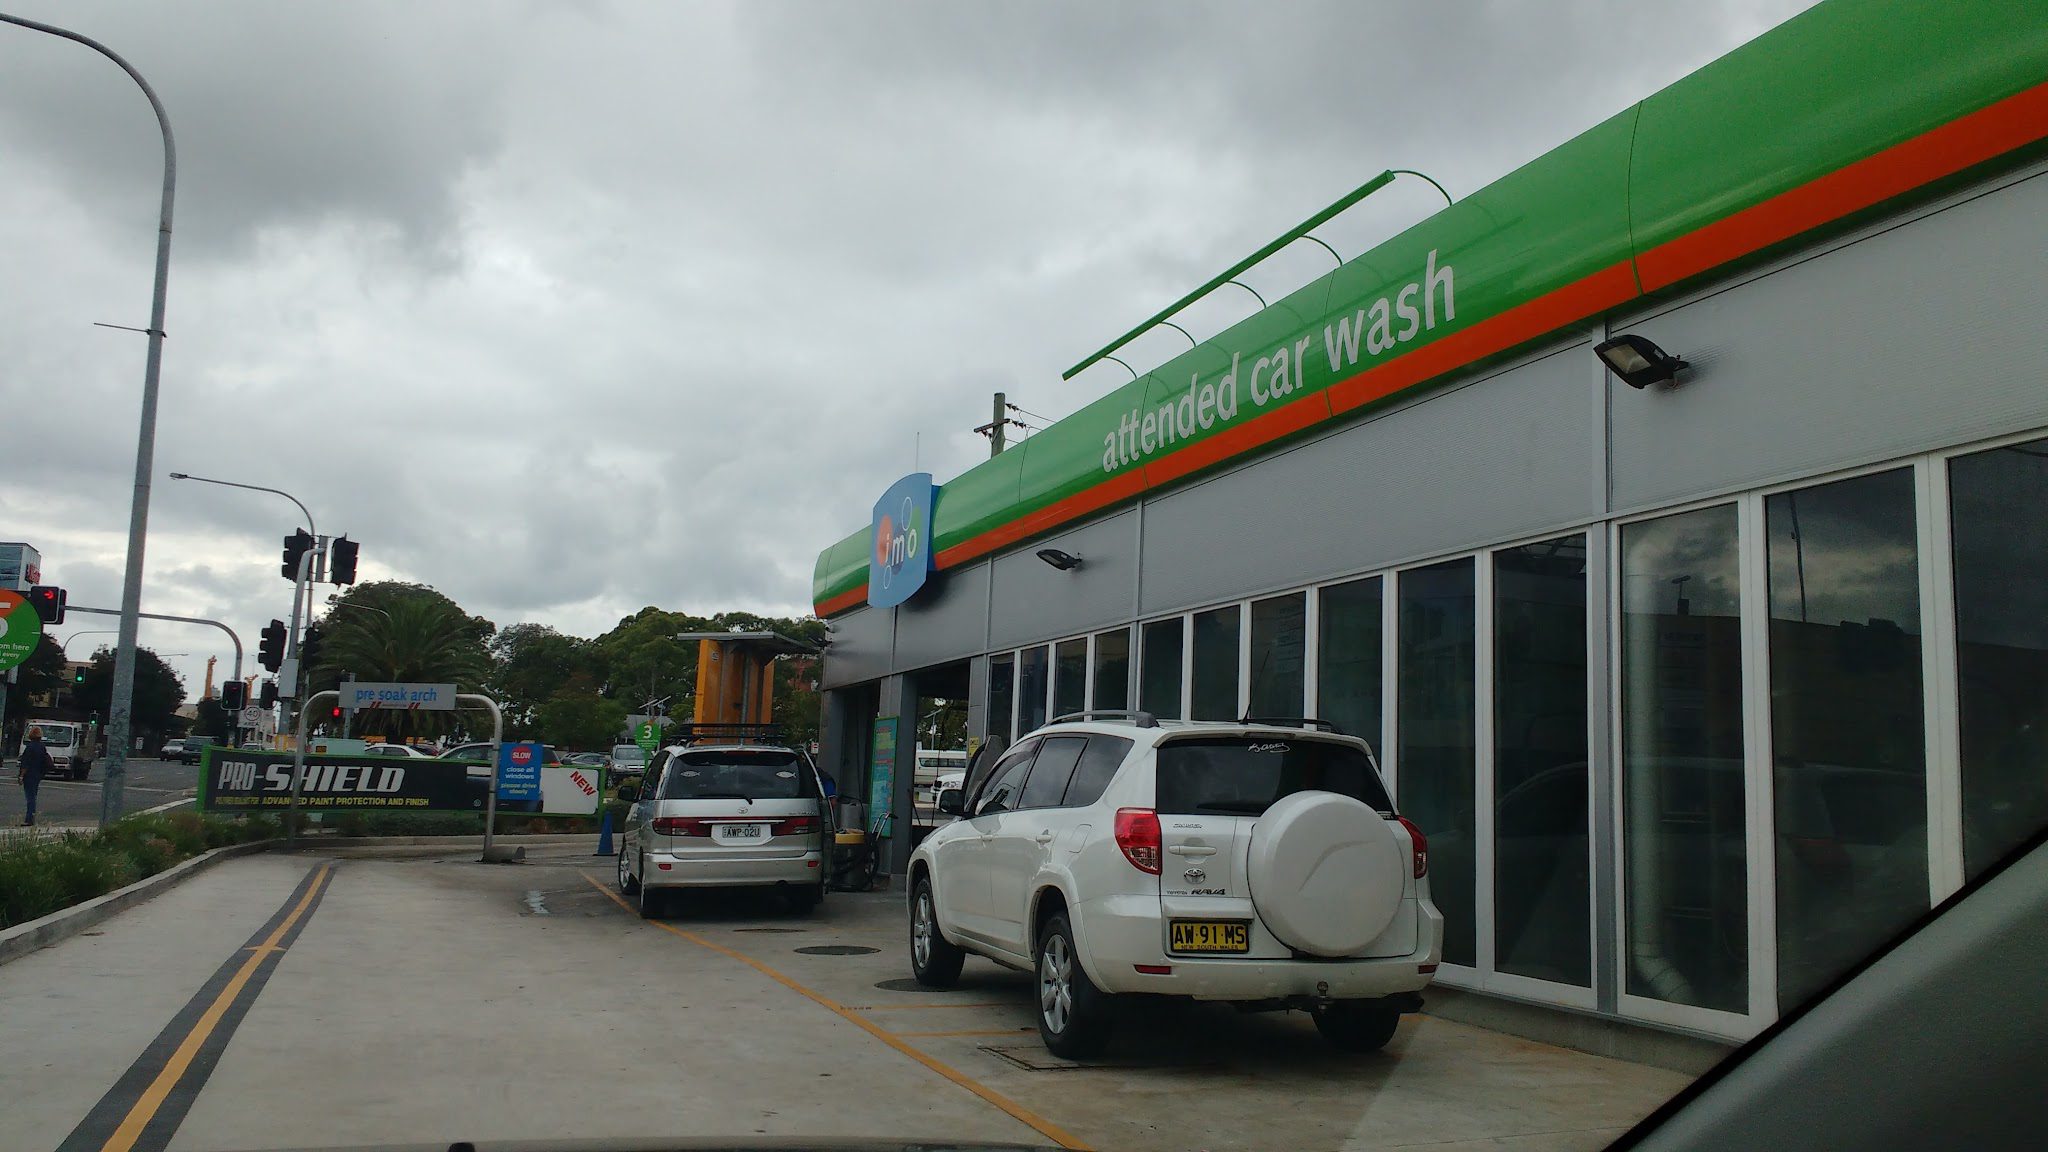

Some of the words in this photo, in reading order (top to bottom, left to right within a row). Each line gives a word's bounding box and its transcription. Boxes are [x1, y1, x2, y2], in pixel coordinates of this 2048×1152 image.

[1102, 352, 1240, 473] attended
[1250, 335, 1310, 407] car
[1324, 249, 1455, 372] wash
[885, 528, 917, 567] imo
[12, 642, 30, 651] here
[355, 689, 375, 703] pre
[379, 687, 407, 701] soak
[410, 687, 437, 702] arch
[643, 725, 652, 739] 3
[512, 752, 531, 760] SLOW
[217, 761, 406, 792] PRO-SHIELD
[570, 770, 597, 796] NEW
[262, 797, 309, 805] ADVANED
[309, 797, 335, 806] PAINT
[336, 797, 386, 806] PROTECTION
[387, 798, 404, 806] AND
[405, 798, 429, 806] FINISH
